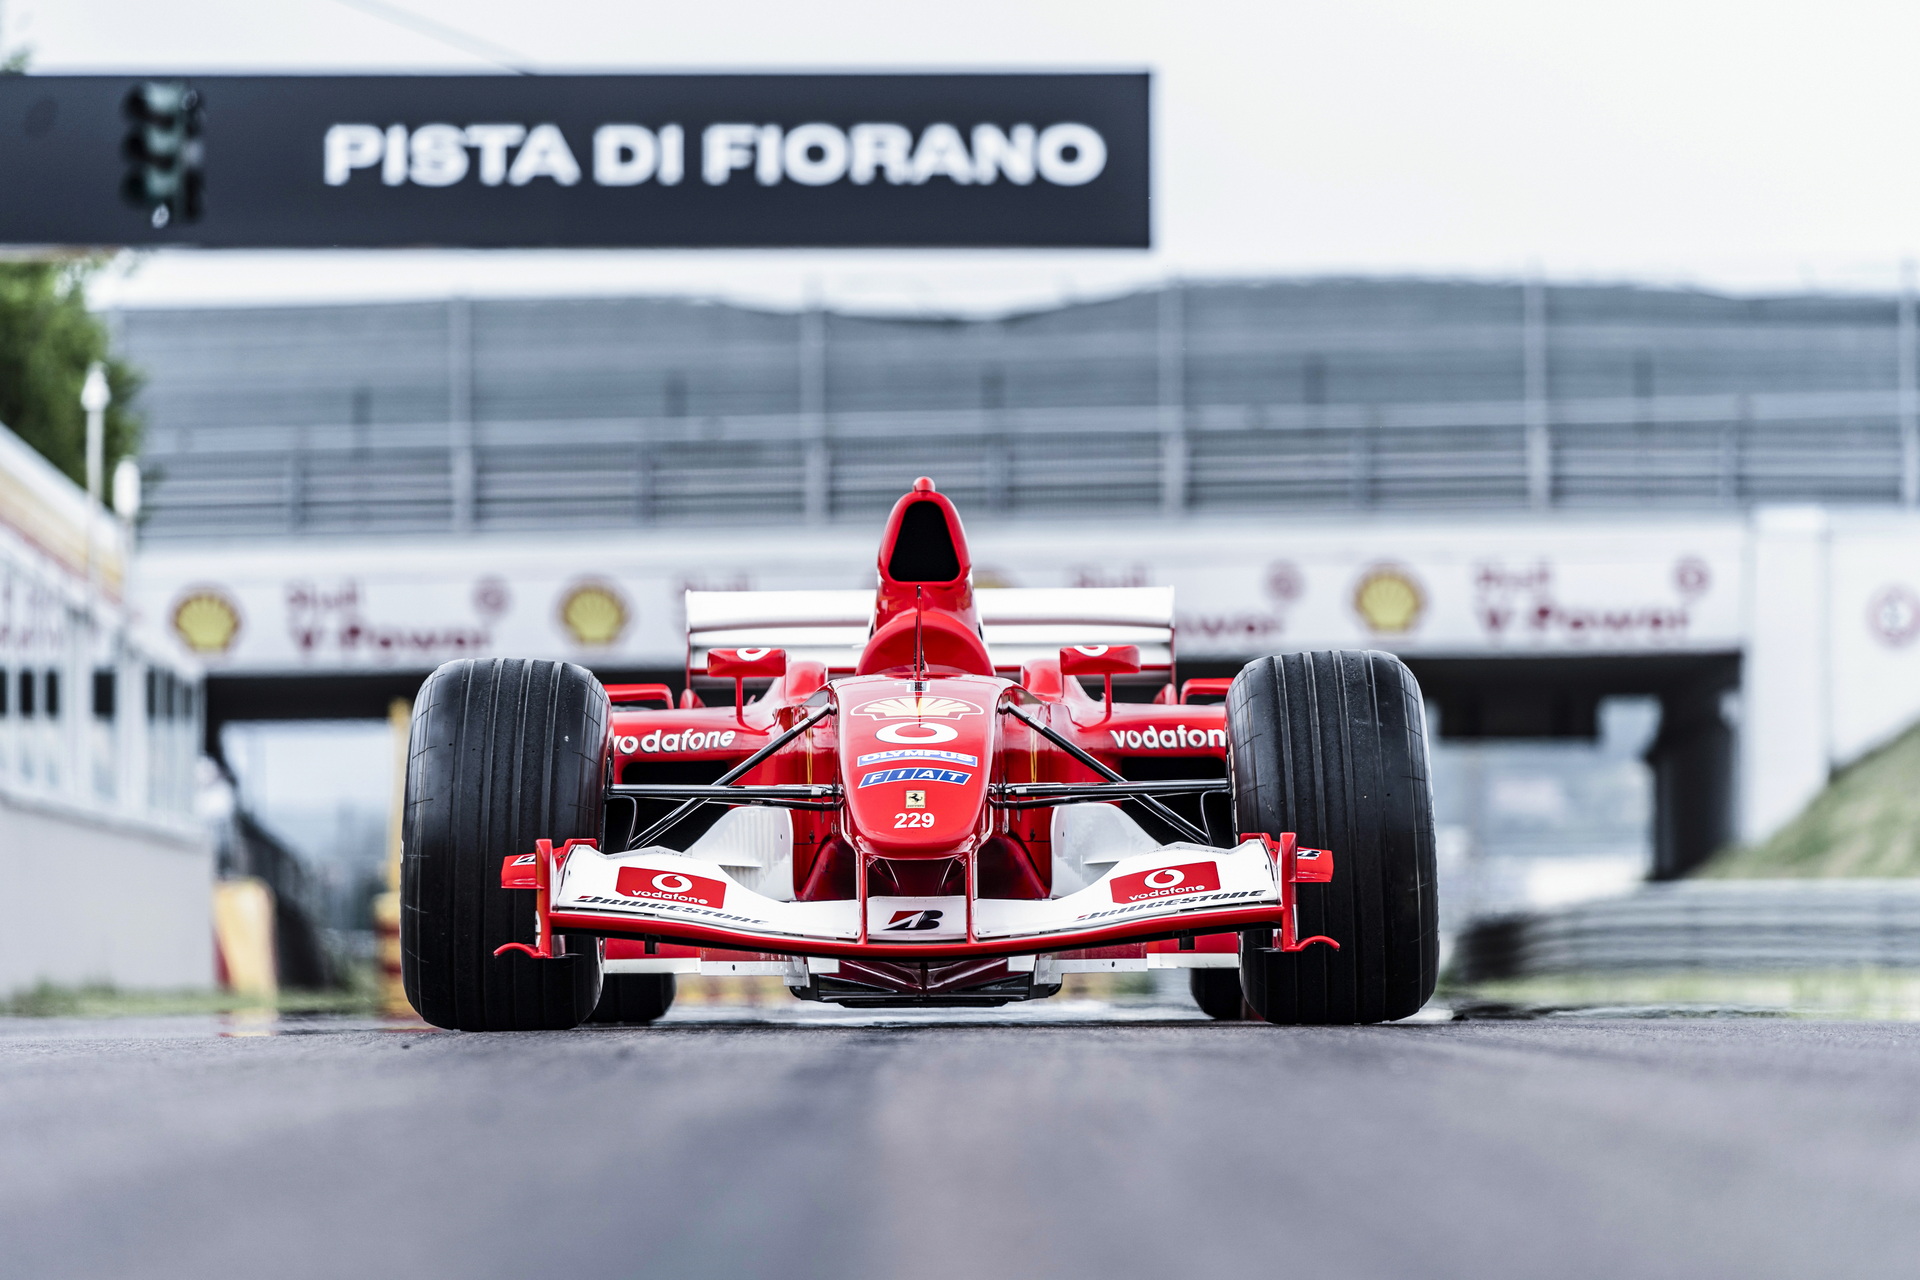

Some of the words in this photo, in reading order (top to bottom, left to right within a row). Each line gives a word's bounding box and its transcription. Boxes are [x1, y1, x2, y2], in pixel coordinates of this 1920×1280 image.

[324, 122, 581, 187] PISTA
[593, 122, 684, 187] DI
[702, 122, 1107, 187] FIORANO
[1110, 724, 1226, 750] vodafon
[861, 750, 974, 764] OLYMPUS
[868, 769, 965, 785] FIAT
[894, 812, 935, 829] 229
[631, 888, 709, 906] vodafone
[1128, 884, 1206, 902] vodafone
